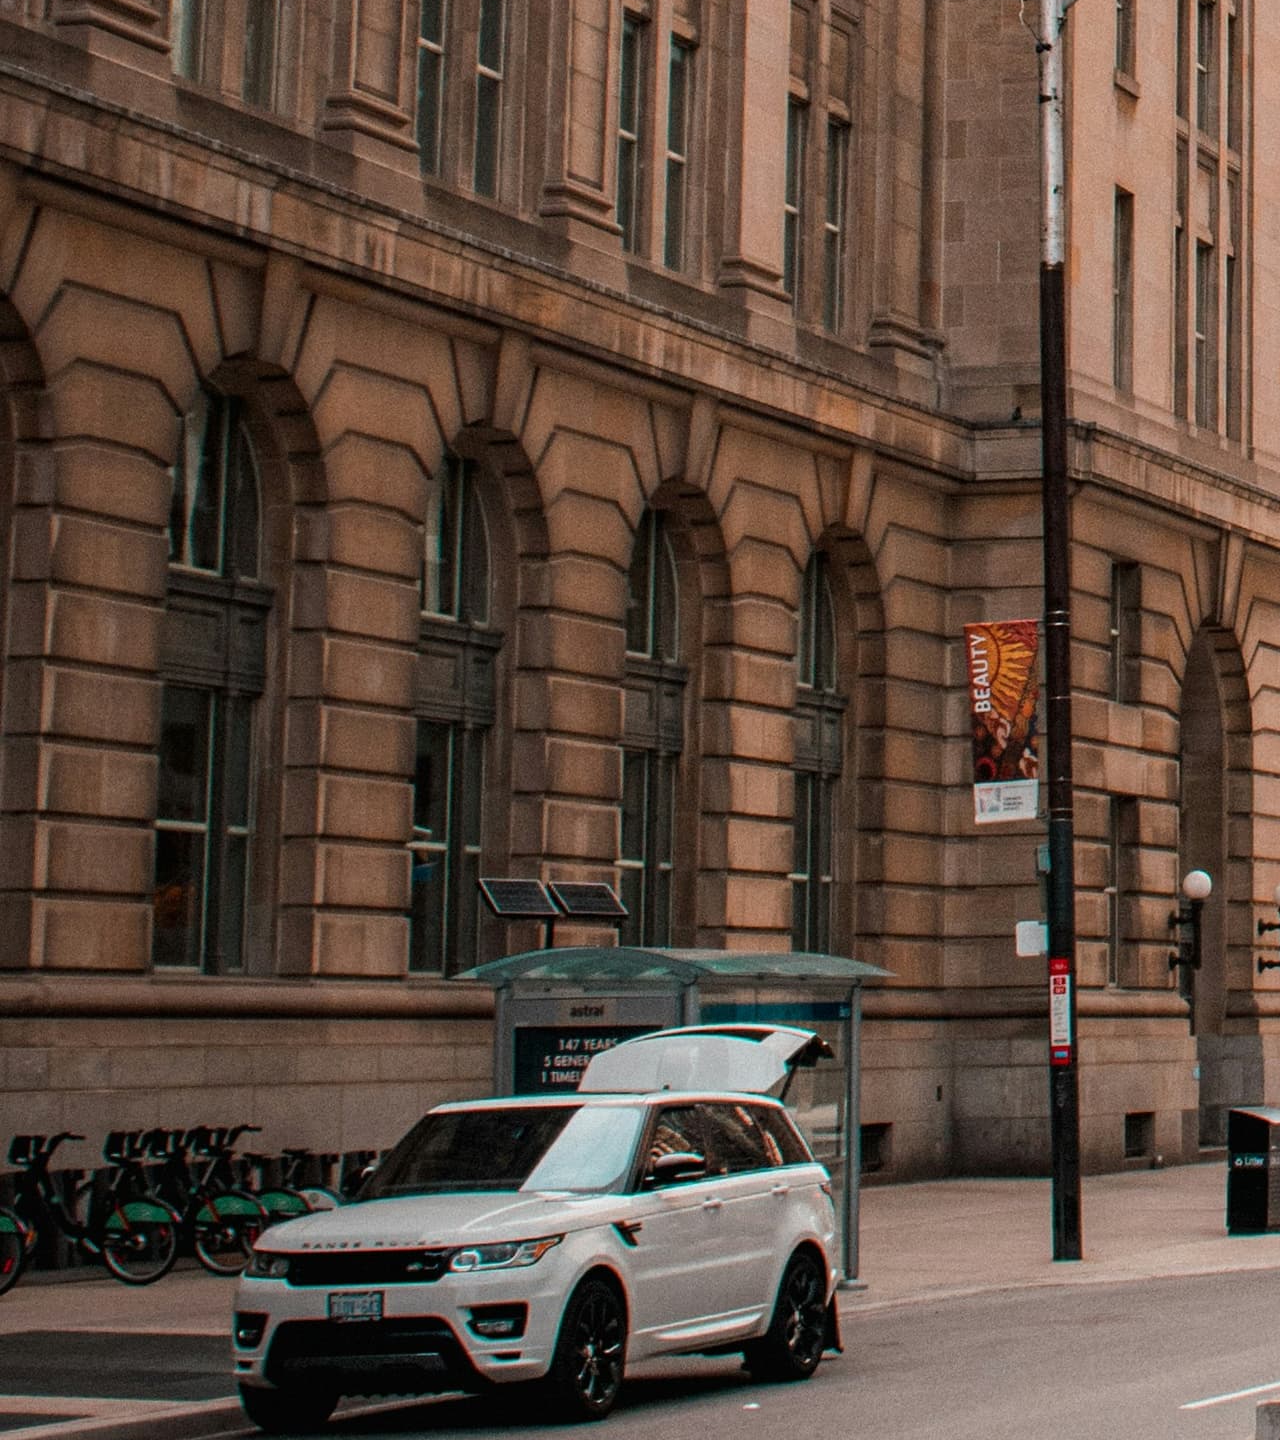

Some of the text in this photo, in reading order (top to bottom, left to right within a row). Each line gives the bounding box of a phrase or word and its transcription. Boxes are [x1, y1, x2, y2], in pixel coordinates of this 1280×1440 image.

[970, 633, 992, 713] BEAUTY
[570, 1004, 605, 1017] astral
[560, 1038, 579, 1051] 147
[544, 1055, 552, 1068] 5
